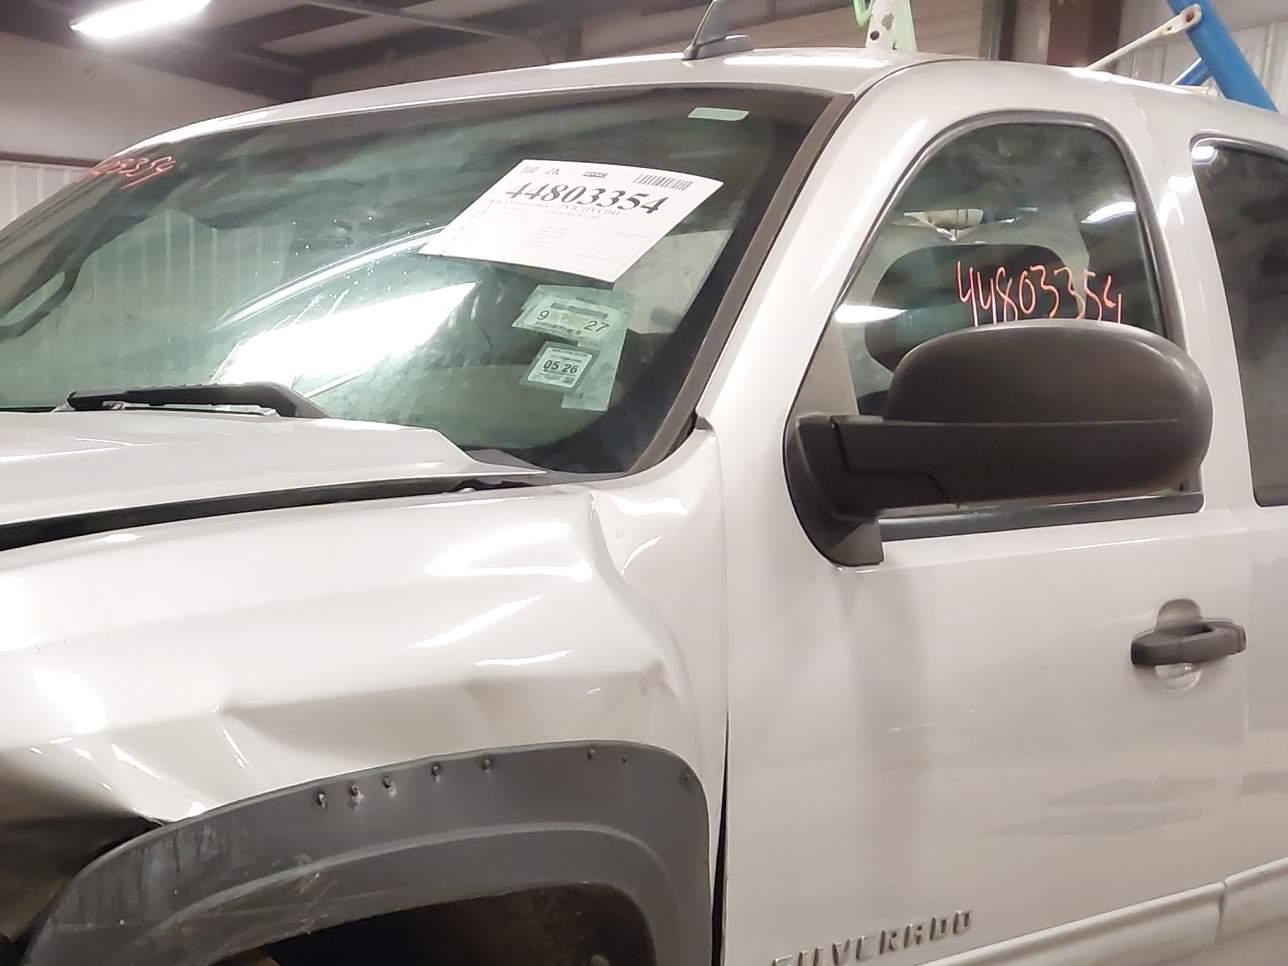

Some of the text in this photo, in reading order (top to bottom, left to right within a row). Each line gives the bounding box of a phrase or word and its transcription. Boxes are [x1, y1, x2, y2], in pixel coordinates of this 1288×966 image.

[506, 181, 670, 215] 44803354
[956, 260, 1124, 328] 44803354
[536, 310, 550, 321] 9
[583, 320, 610, 332] 27
[543, 359, 580, 374] 05 26
